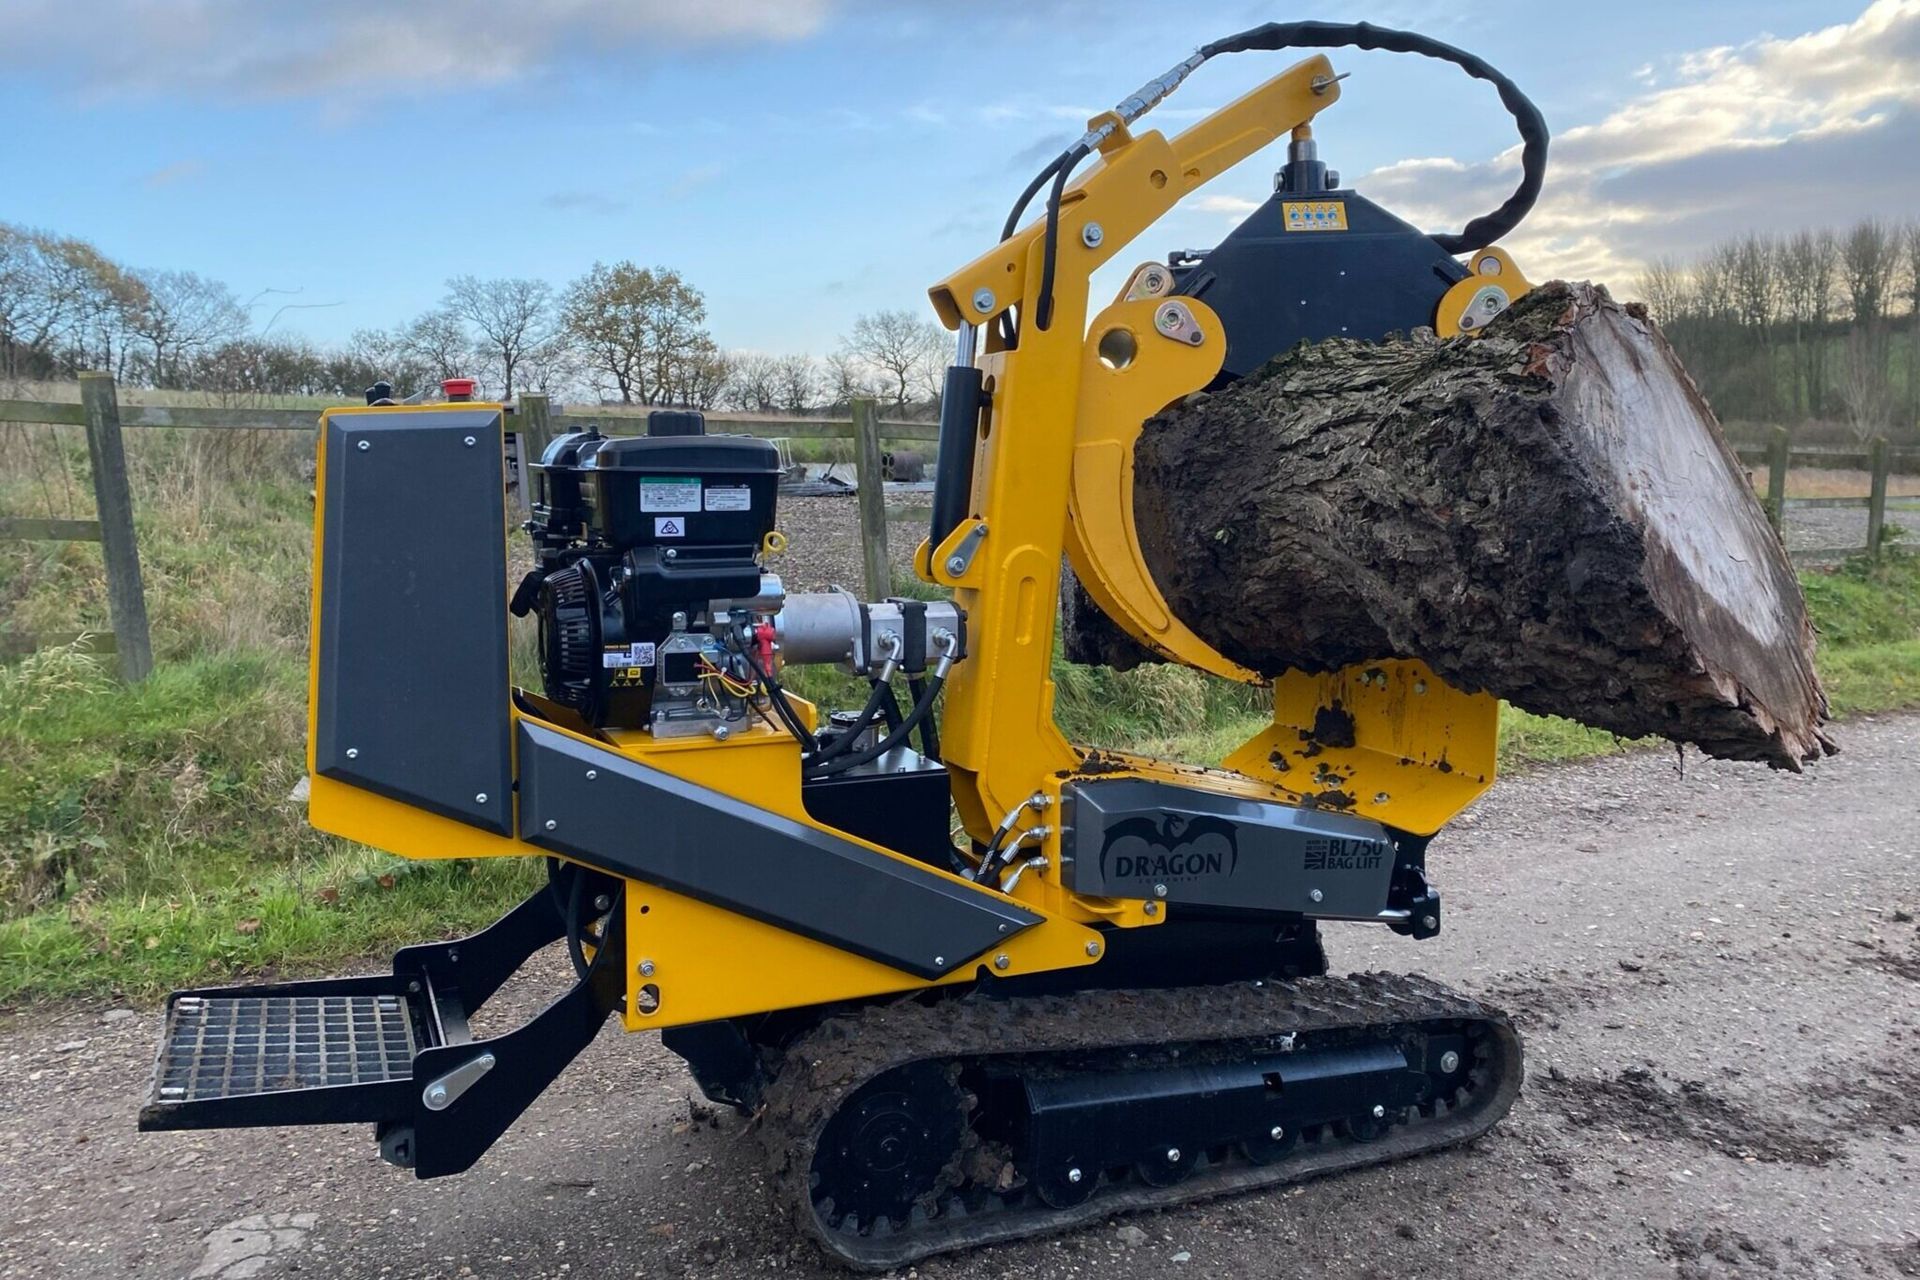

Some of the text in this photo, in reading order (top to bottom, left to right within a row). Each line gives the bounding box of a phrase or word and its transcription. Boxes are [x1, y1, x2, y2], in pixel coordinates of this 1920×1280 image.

[1329, 840, 1383, 856] BL750
[1116, 853, 1222, 877] DRAGON
[1327, 856, 1382, 869] BAG LIFT
